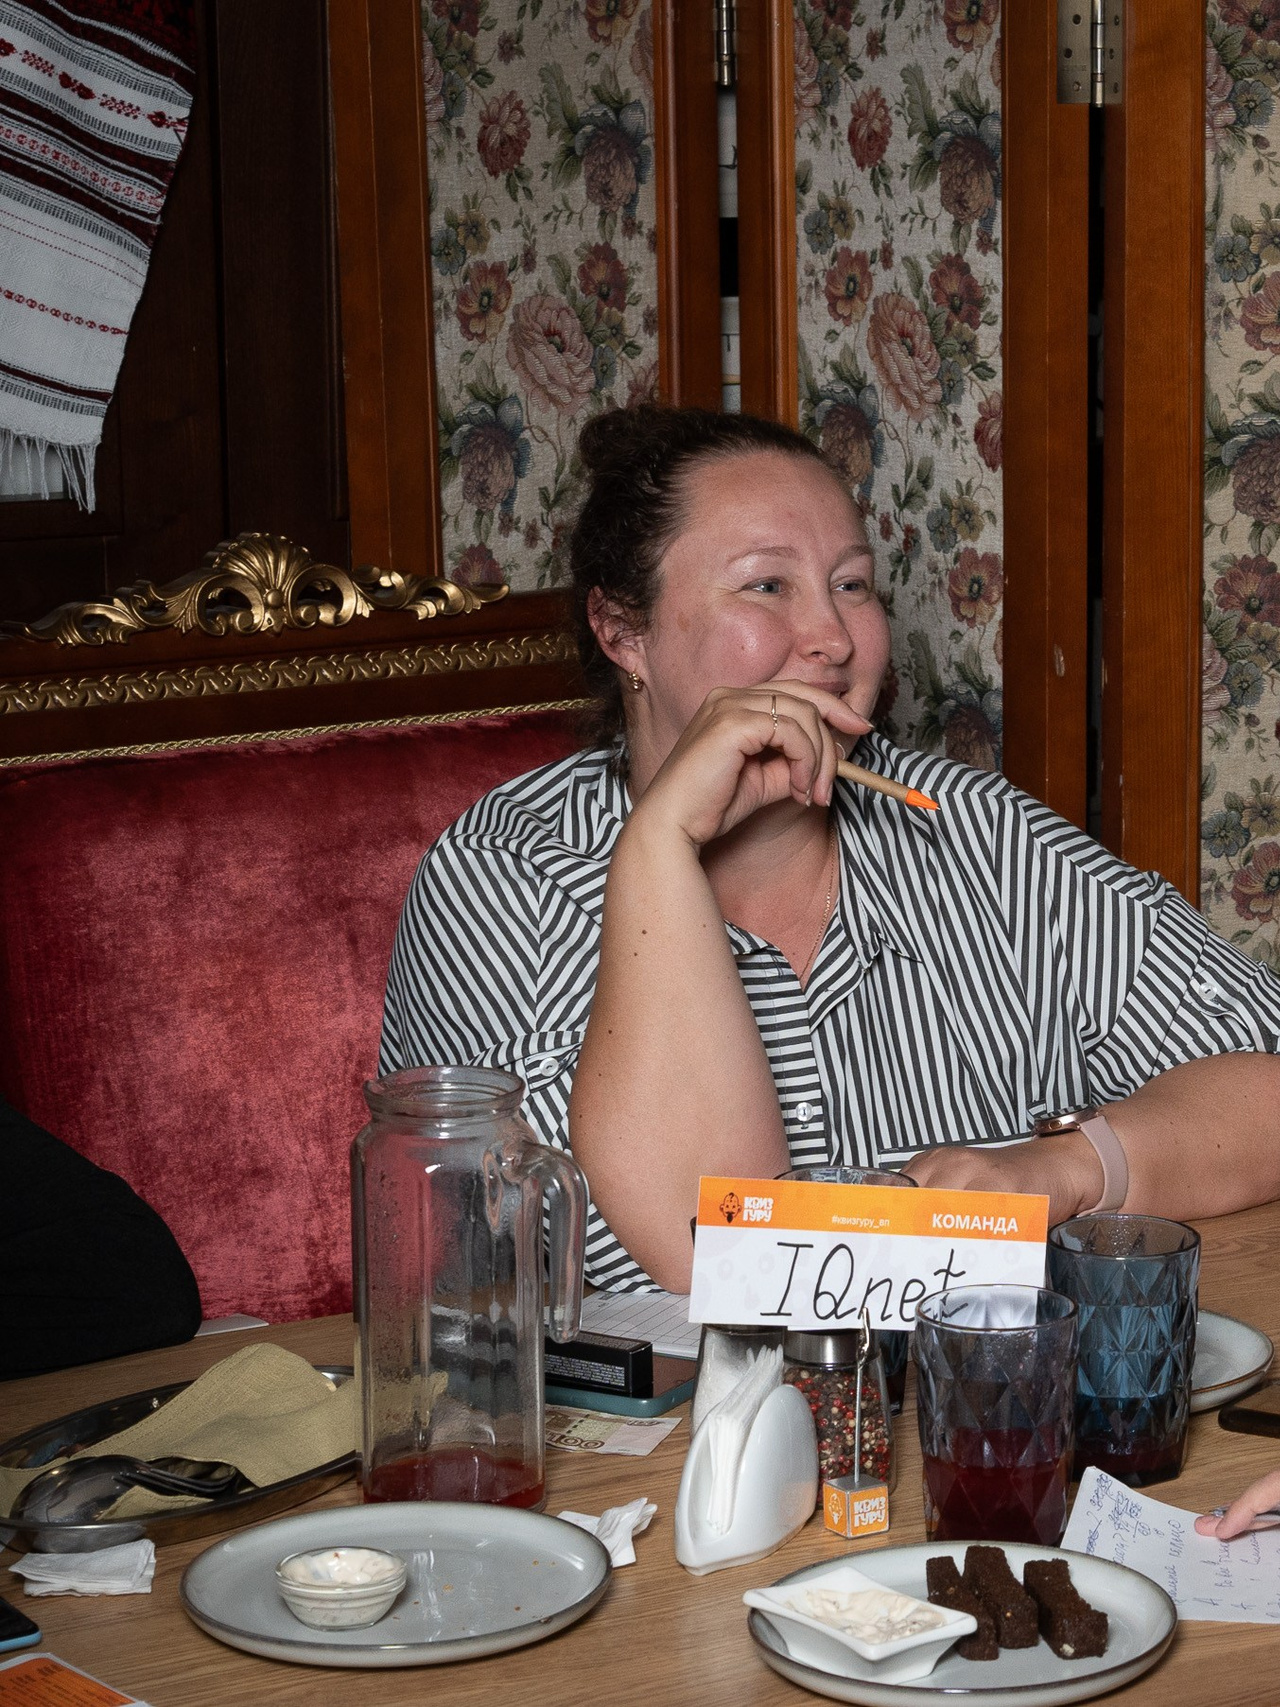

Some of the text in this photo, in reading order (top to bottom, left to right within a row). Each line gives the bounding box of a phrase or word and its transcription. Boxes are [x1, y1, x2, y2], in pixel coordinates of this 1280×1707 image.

[743, 1196, 774, 1210] КВИЗ
[742, 1209, 772, 1223] ГУРУ
[932, 1213, 1019, 1235] КОМАНДА
[760, 1242, 968, 1323] IQnet
[853, 1497, 886, 1514] КВИЗ
[853, 1509, 886, 1527] ГУРУ
